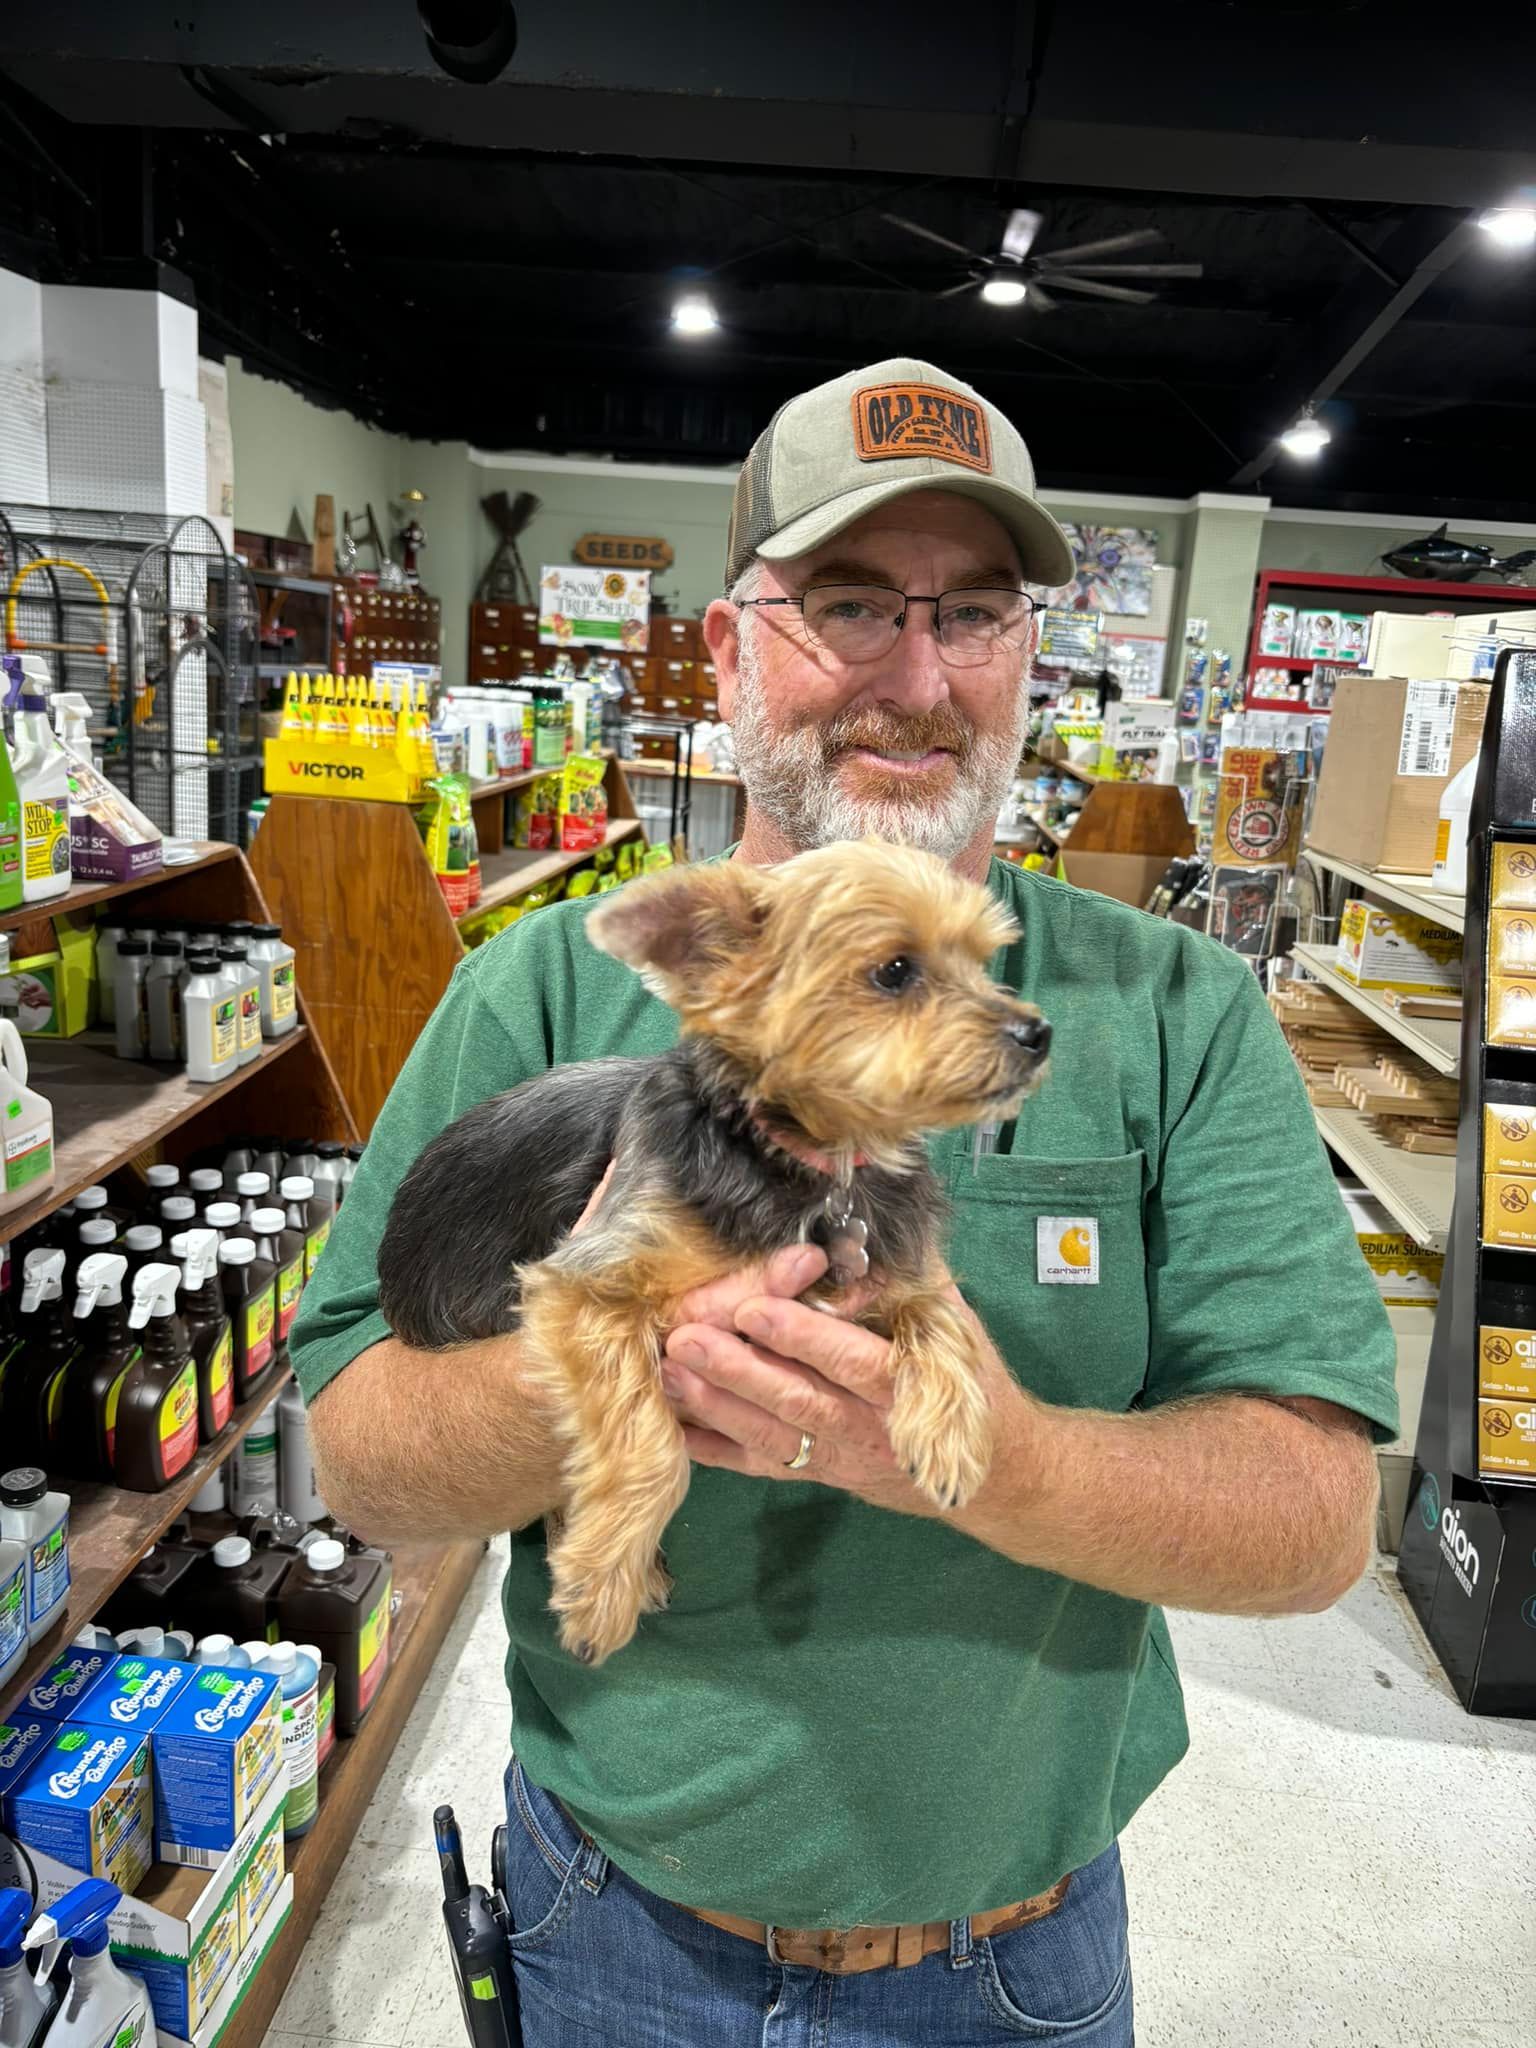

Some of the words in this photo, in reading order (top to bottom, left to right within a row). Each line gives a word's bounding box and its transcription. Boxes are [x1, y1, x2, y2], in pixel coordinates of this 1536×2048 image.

[868, 394, 913, 445] OLD
[918, 395, 980, 457] TYME
[586, 541, 663, 561] SEEDS
[288, 761, 364, 780] VICTOR
[26, 803, 50, 819] WILT
[26, 818, 52, 835] STOP
[91, 837, 109, 849] SC
[1419, 928, 1460, 942] MEDIUM
[1361, 1243, 1399, 1256] EDIUM
[1046, 1267, 1091, 1275] carhartt
[36, 1659, 84, 1702] Rouup
[118, 1669, 164, 1713] Roundup
[143, 1666, 183, 1709] QuikPRO
[204, 1679, 246, 1724] Roundup
[228, 1676, 265, 1719] QuikPRO
[57, 1739, 108, 1789] Roundup
[83, 1736, 127, 1785] QuikPRO
